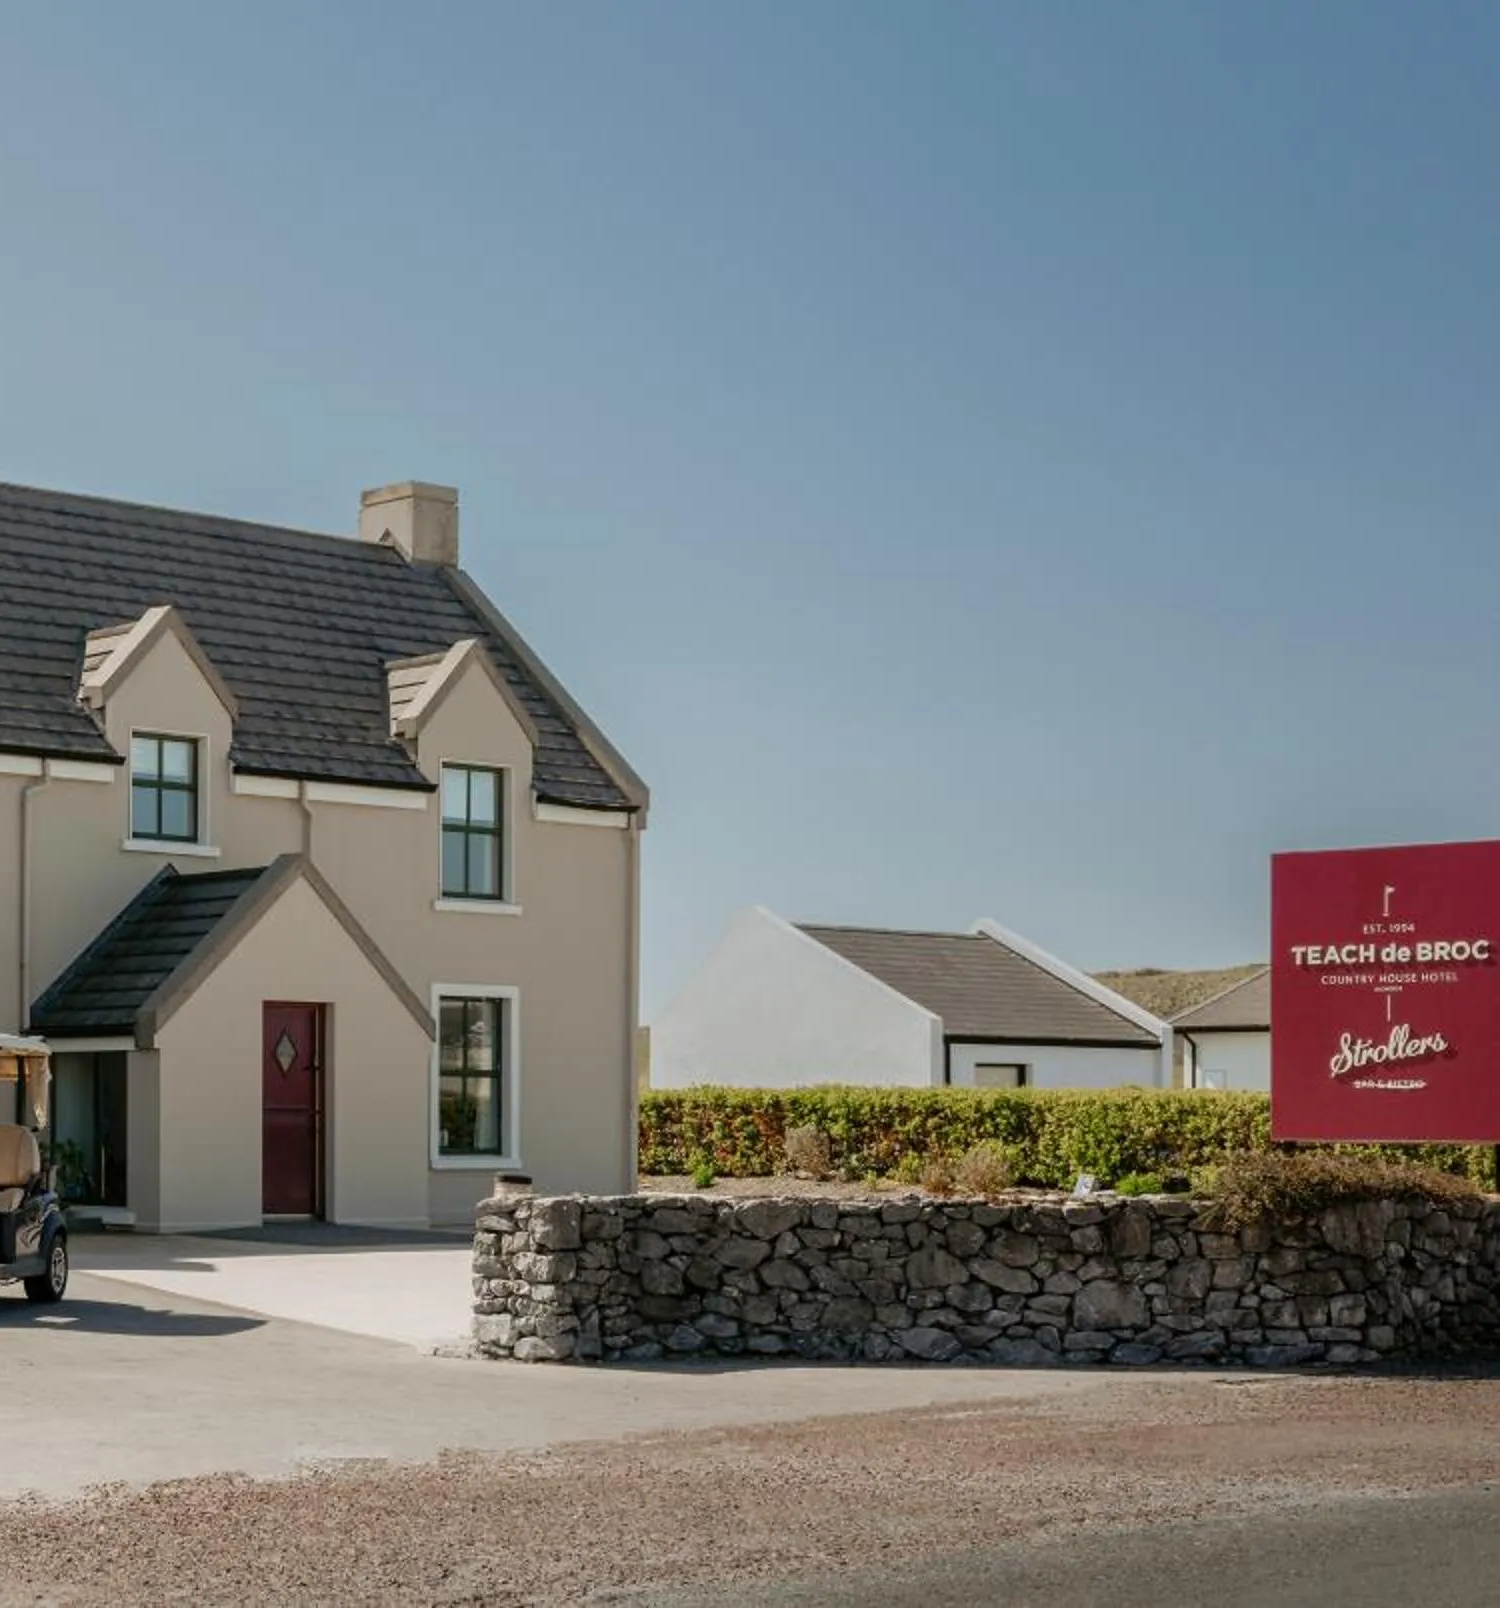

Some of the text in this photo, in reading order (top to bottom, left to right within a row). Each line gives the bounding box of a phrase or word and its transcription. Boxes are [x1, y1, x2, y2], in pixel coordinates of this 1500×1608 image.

[1363, 923, 1386, 935] EST.
[1291, 940, 1490, 965] TEACH de BROC
[1321, 971, 1458, 985] COUNTRY HOUSE HOTEL
[1330, 1023, 1448, 1077] Strollers
